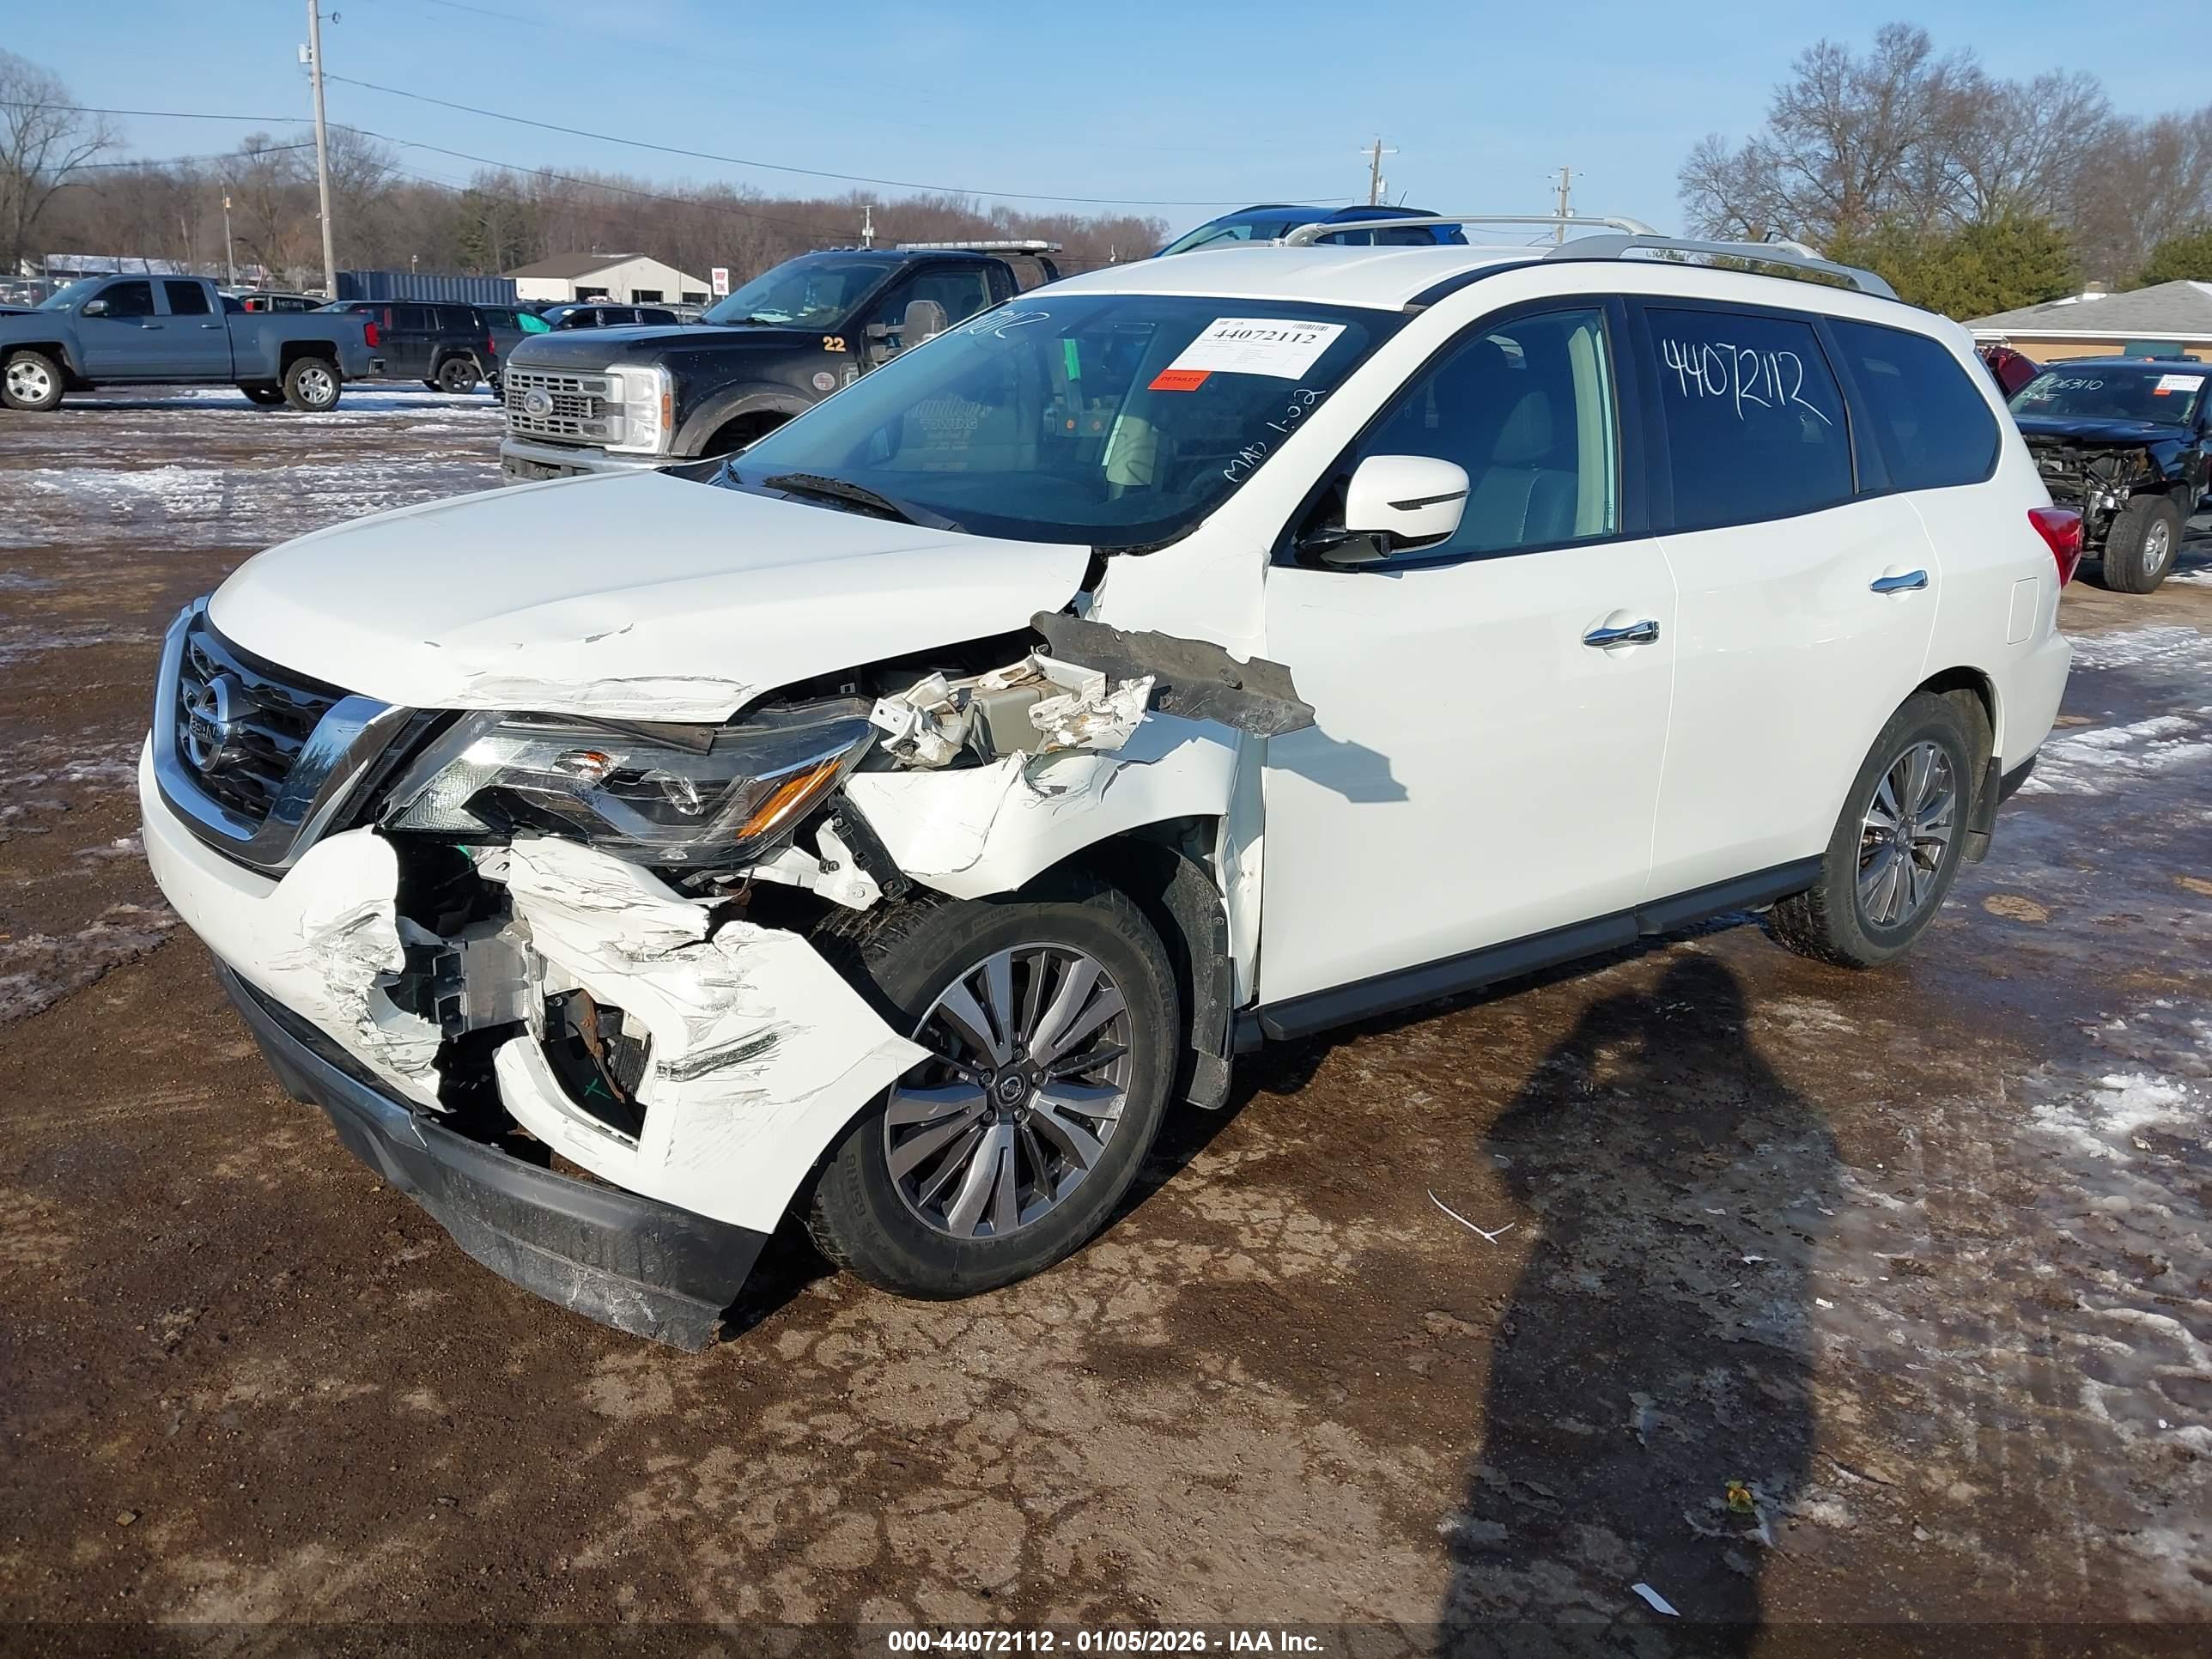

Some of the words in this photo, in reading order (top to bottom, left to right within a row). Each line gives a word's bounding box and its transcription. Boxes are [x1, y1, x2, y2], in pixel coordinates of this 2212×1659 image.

[823, 336, 847, 352] 22
[1213, 328, 1318, 344] 44072112
[1662, 338, 1833, 427] 44072112
